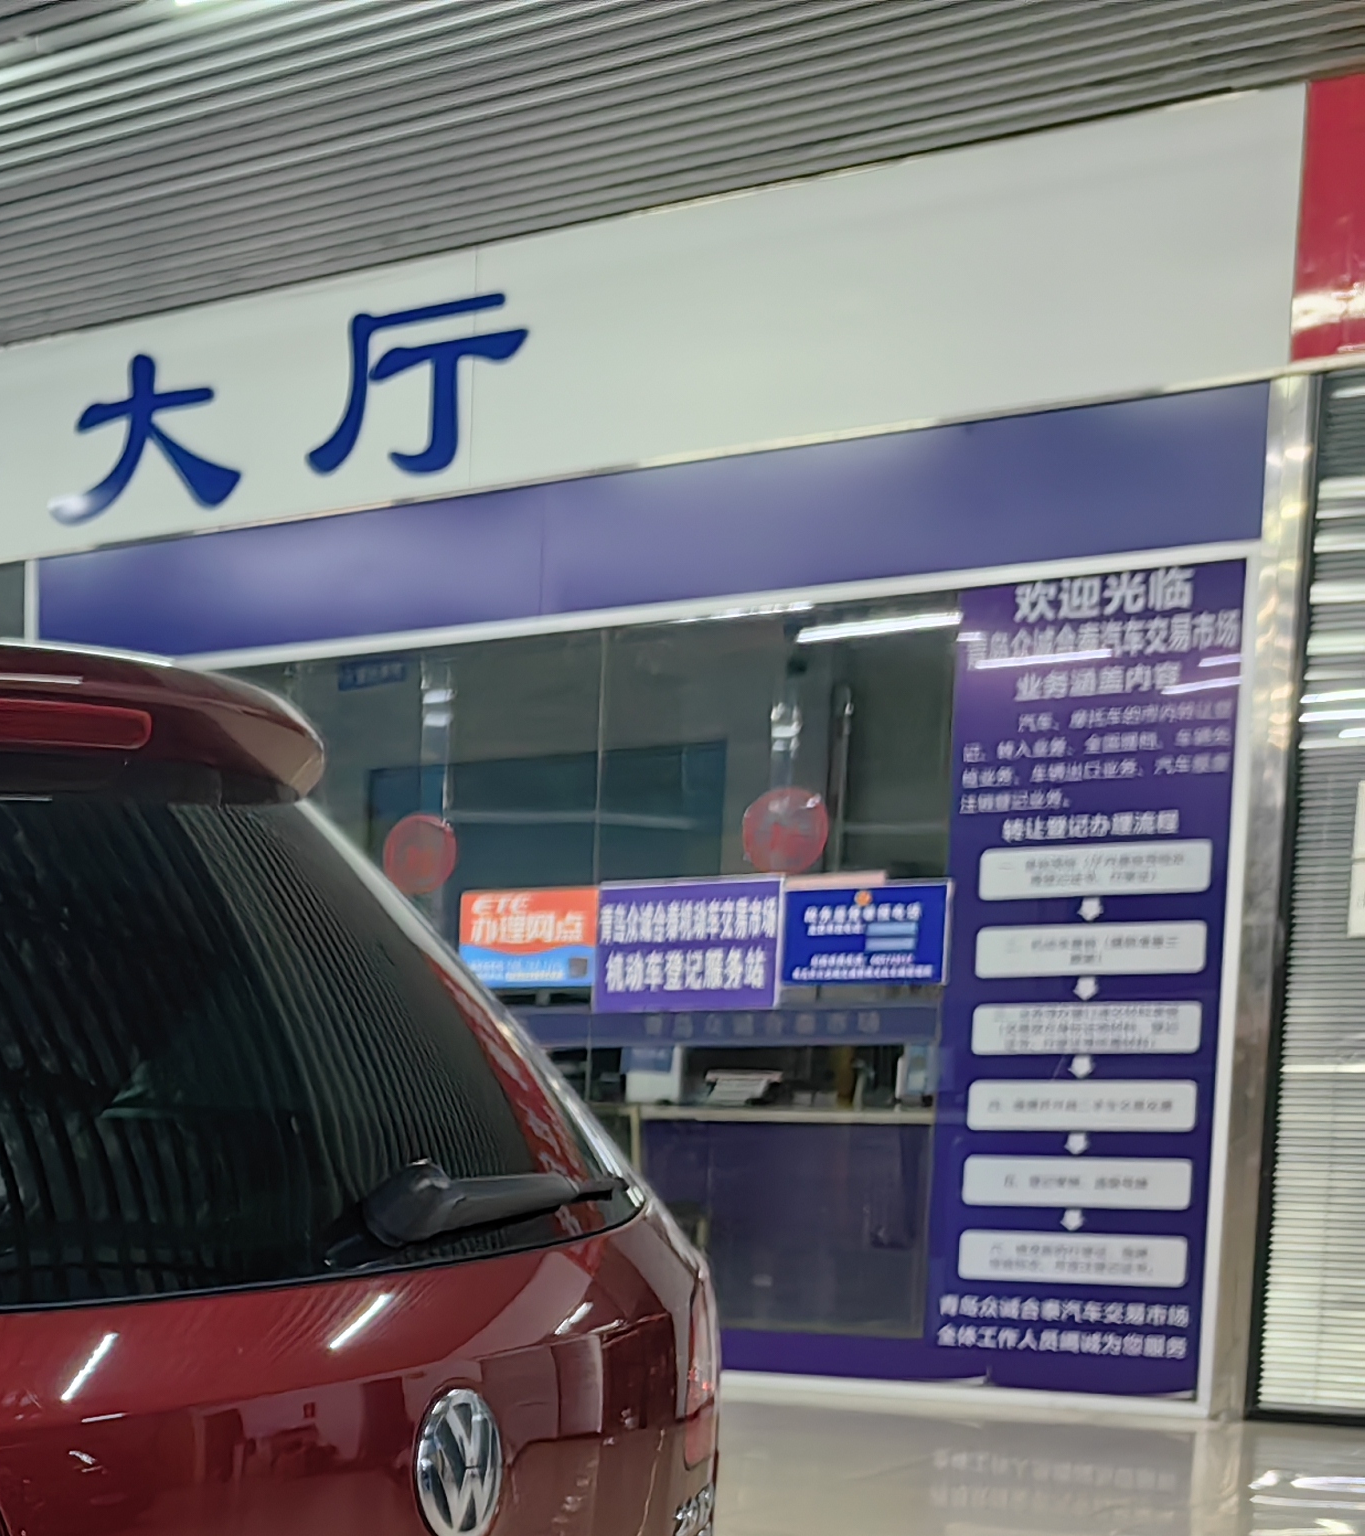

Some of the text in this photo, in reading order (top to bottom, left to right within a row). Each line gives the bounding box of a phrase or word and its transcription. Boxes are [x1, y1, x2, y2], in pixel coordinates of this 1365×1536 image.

[1013, 566, 1196, 623] 欢迎光临
[1014, 661, 1181, 702] 业务涵盖内容
[1001, 809, 1180, 843] 转让登记办理流程
[471, 893, 531, 914] ETC
[470, 911, 584, 944] 办理网点
[605, 945, 766, 993] 机动车登记服务站
